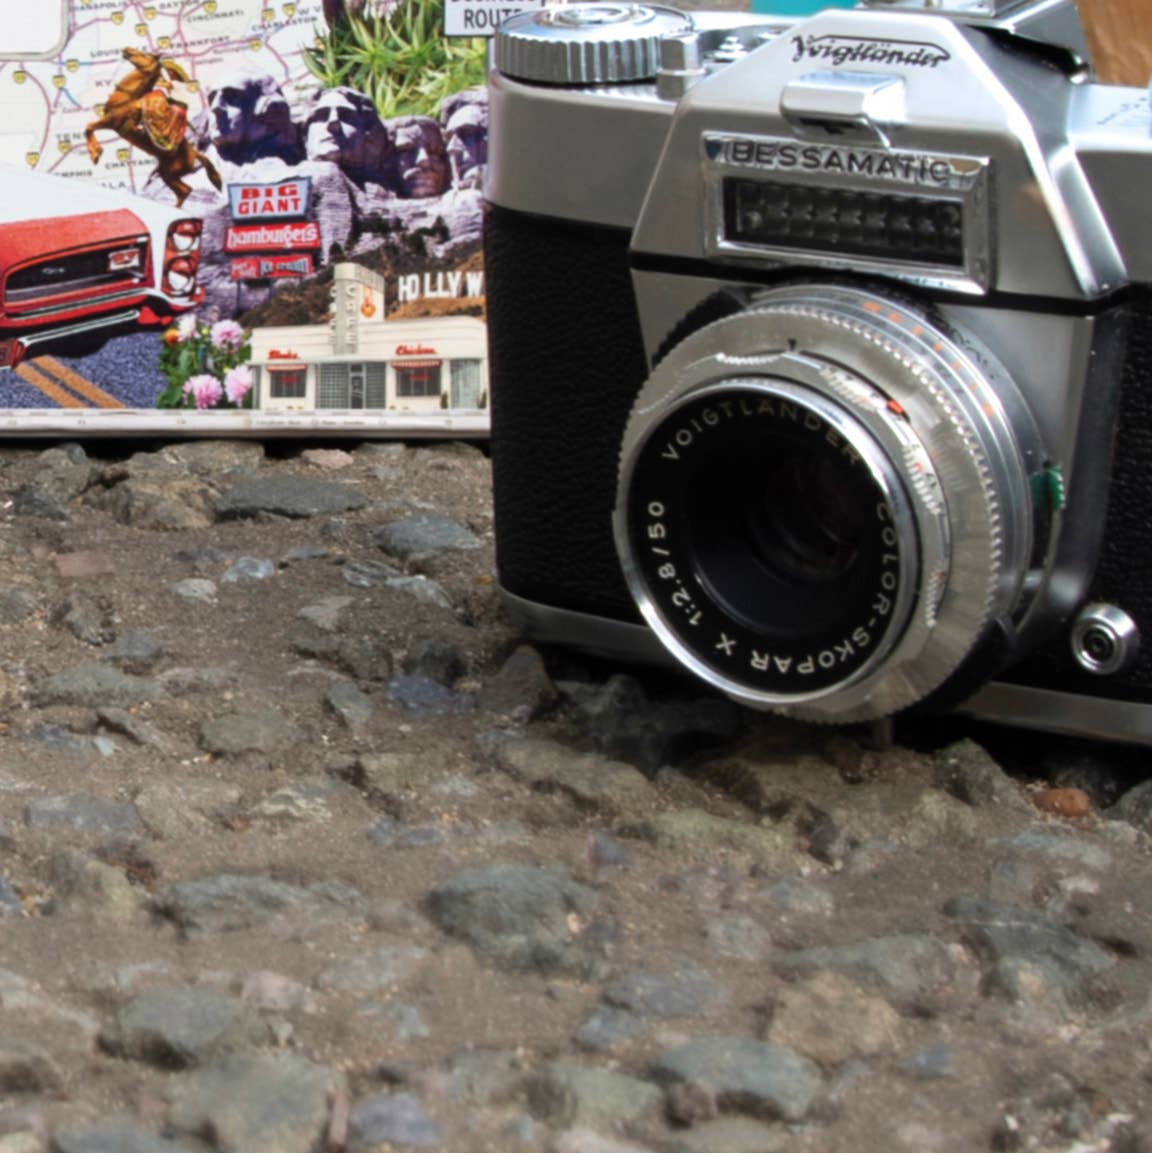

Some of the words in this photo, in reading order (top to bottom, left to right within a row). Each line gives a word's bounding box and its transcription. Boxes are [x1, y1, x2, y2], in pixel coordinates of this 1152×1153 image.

[463, 8, 523, 30] ROUT
[731, 140, 950, 183] BESSAMATIC
[240, 183, 299, 200] BIG
[237, 197, 302, 215] GIANT
[227, 222, 316, 249] hamburgers
[647, 500, 703, 627] 1:2.8/50
[750, 501, 899, 675] COLOR-SKOPAR
[715, 632, 737, 656] X
